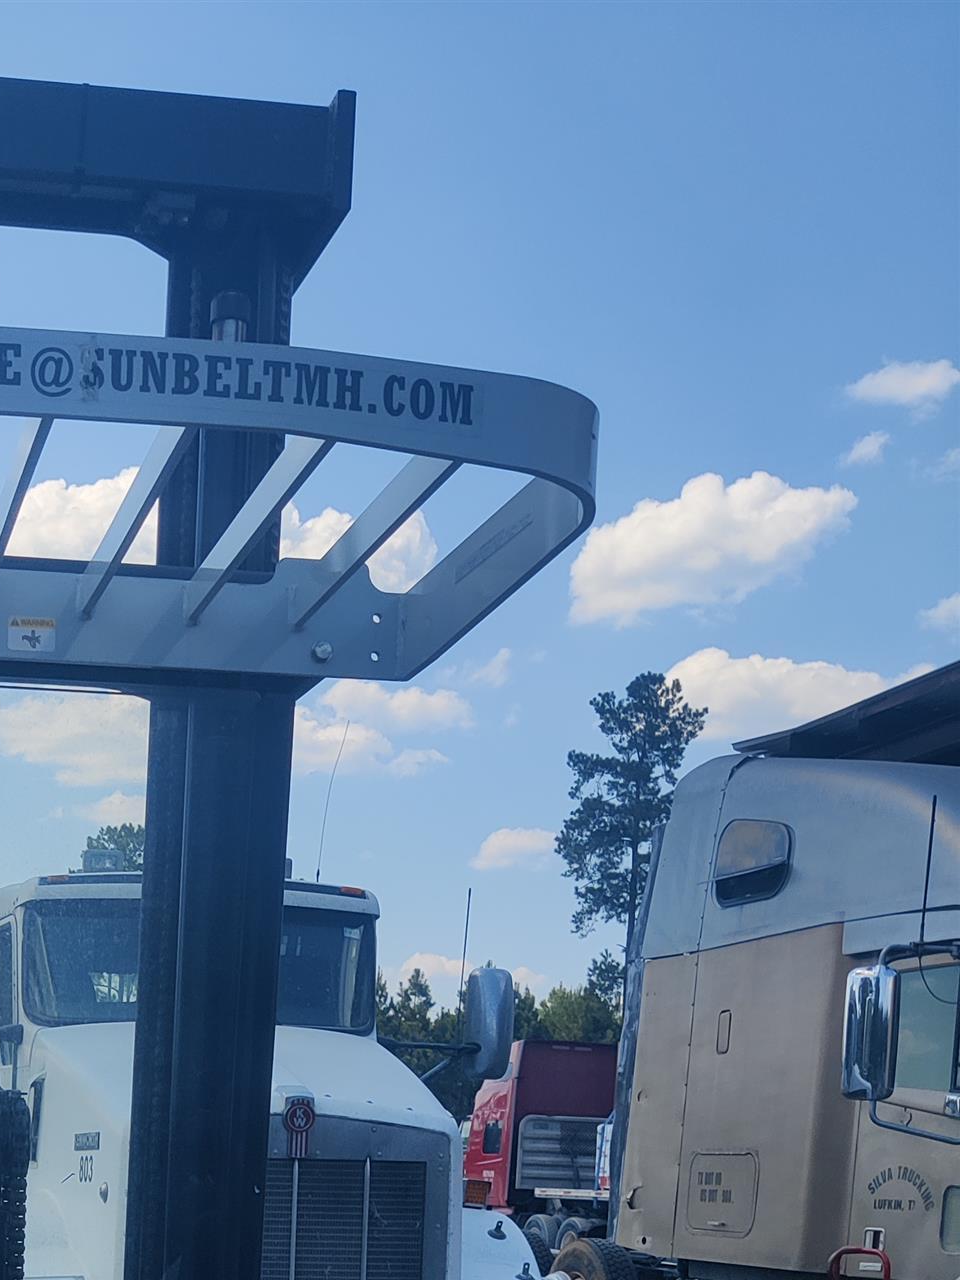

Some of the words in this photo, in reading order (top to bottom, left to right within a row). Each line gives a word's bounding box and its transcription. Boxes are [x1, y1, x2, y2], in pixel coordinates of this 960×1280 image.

[79, 1155, 94, 1182] 803
[867, 1167, 893, 1195] SILVA
[897, 1165, 935, 1212] TRUCKING
